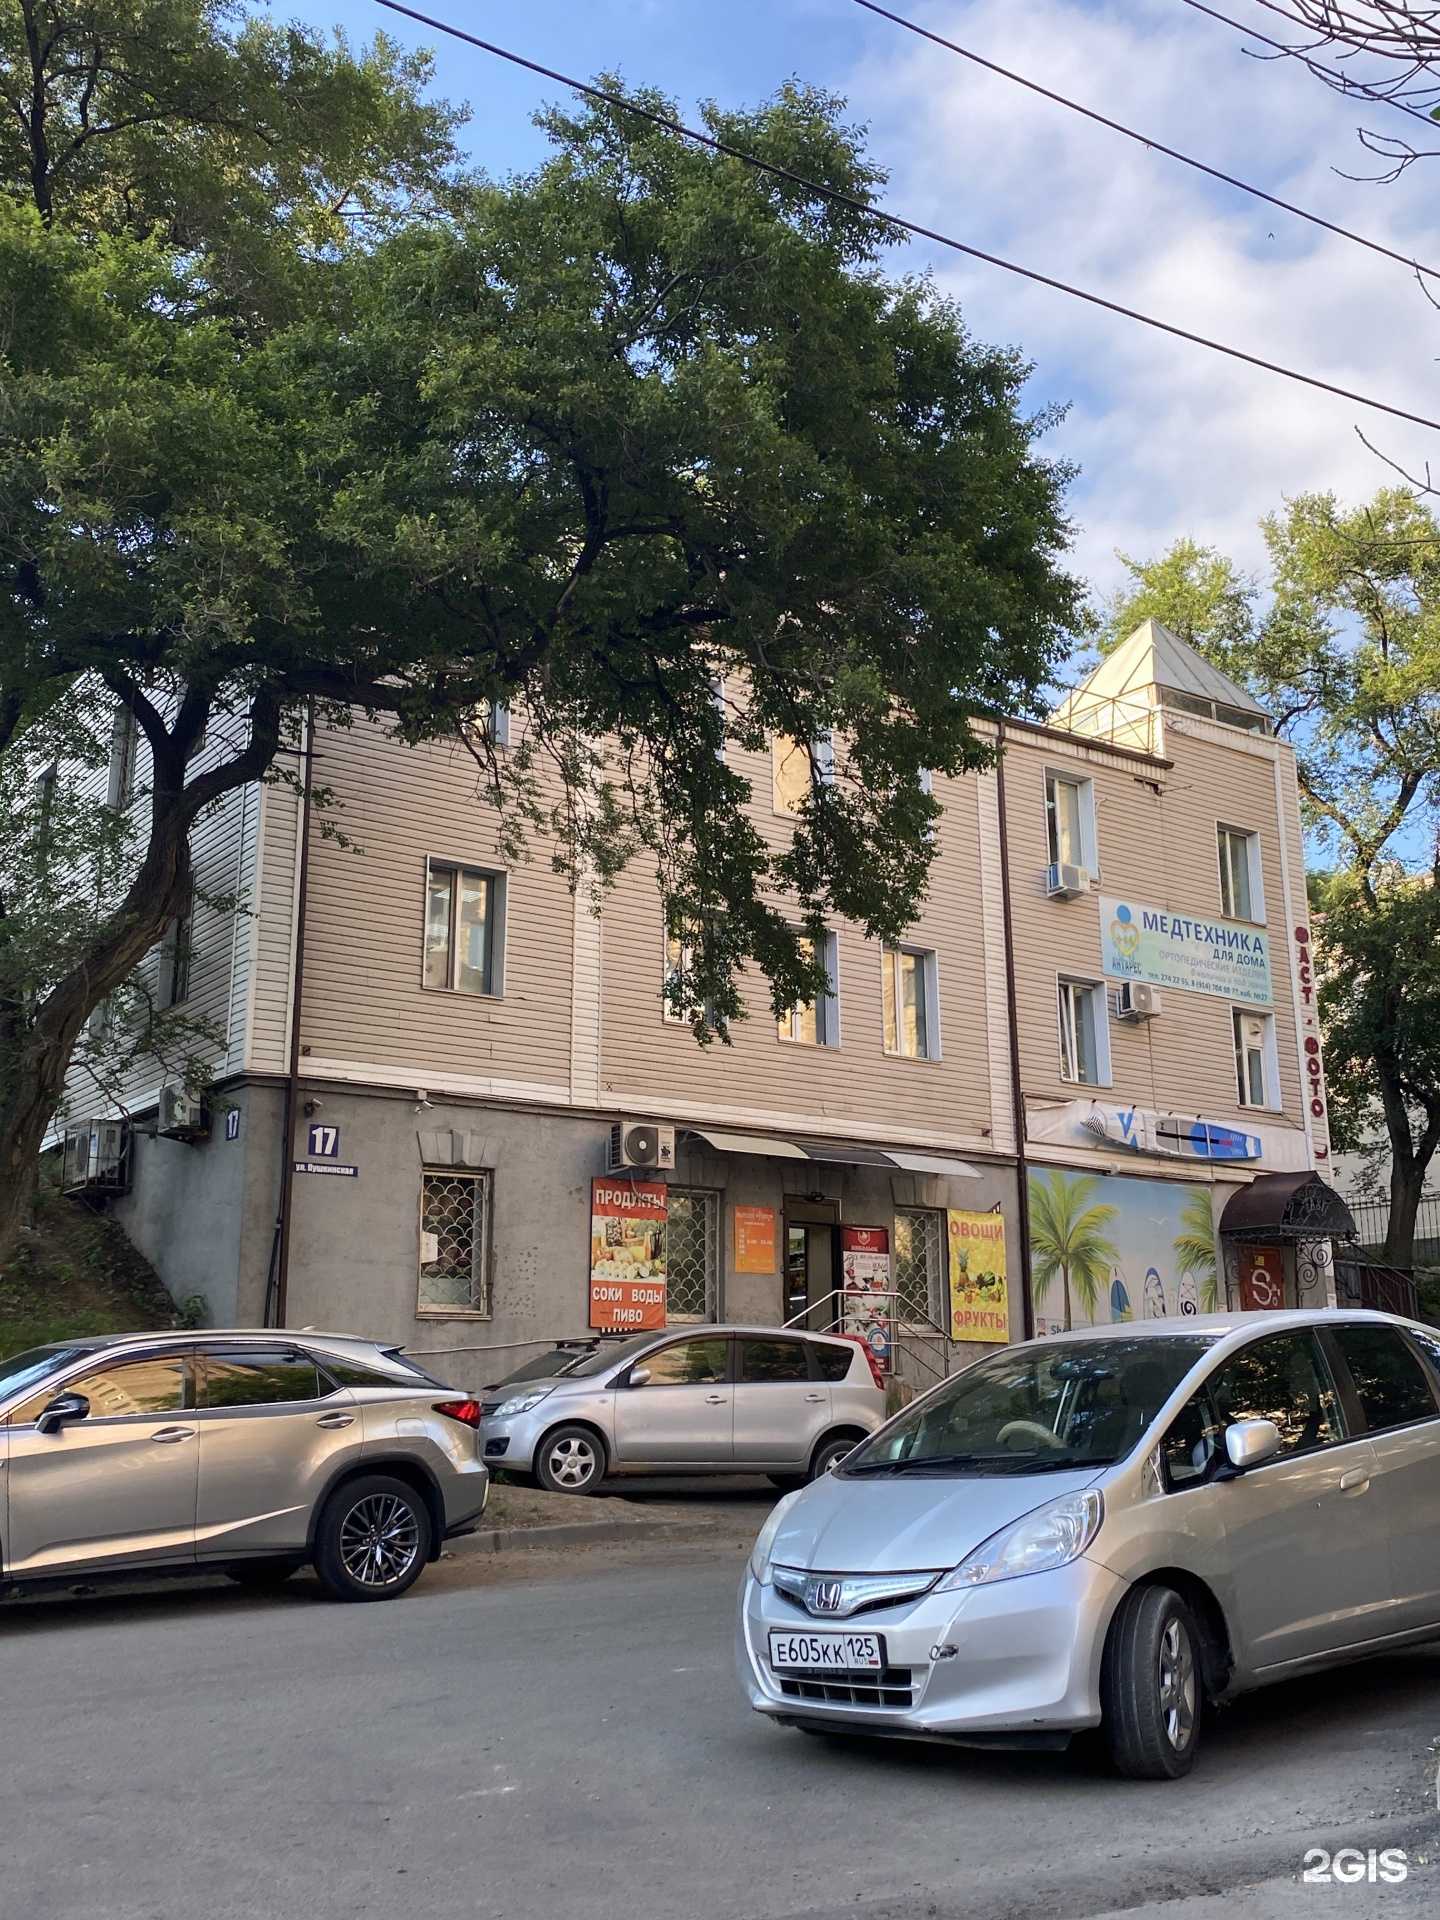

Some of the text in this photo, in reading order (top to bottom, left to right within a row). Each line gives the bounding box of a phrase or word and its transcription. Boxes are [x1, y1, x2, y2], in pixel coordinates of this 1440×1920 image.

[1143, 911, 1264, 954] МЕДТЕХНИКА
[1213, 948, 1266, 969] ДЛЯ ДОМА
[227, 1110, 239, 1138] 17
[311, 1127, 337, 1155] 17
[296, 1163, 354, 1175] ул. Пушкинская
[595, 1189, 665, 1210] ПРОДУКТЫ
[950, 1221, 1003, 1241] ОВОЩИ
[592, 1286, 663, 1304] СОКИ ВОДЫ
[612, 1308, 643, 1323] ПИВО
[953, 1310, 1007, 1330] ФРУКТЫ
[776, 1637, 874, 1664] Е605КК 125
